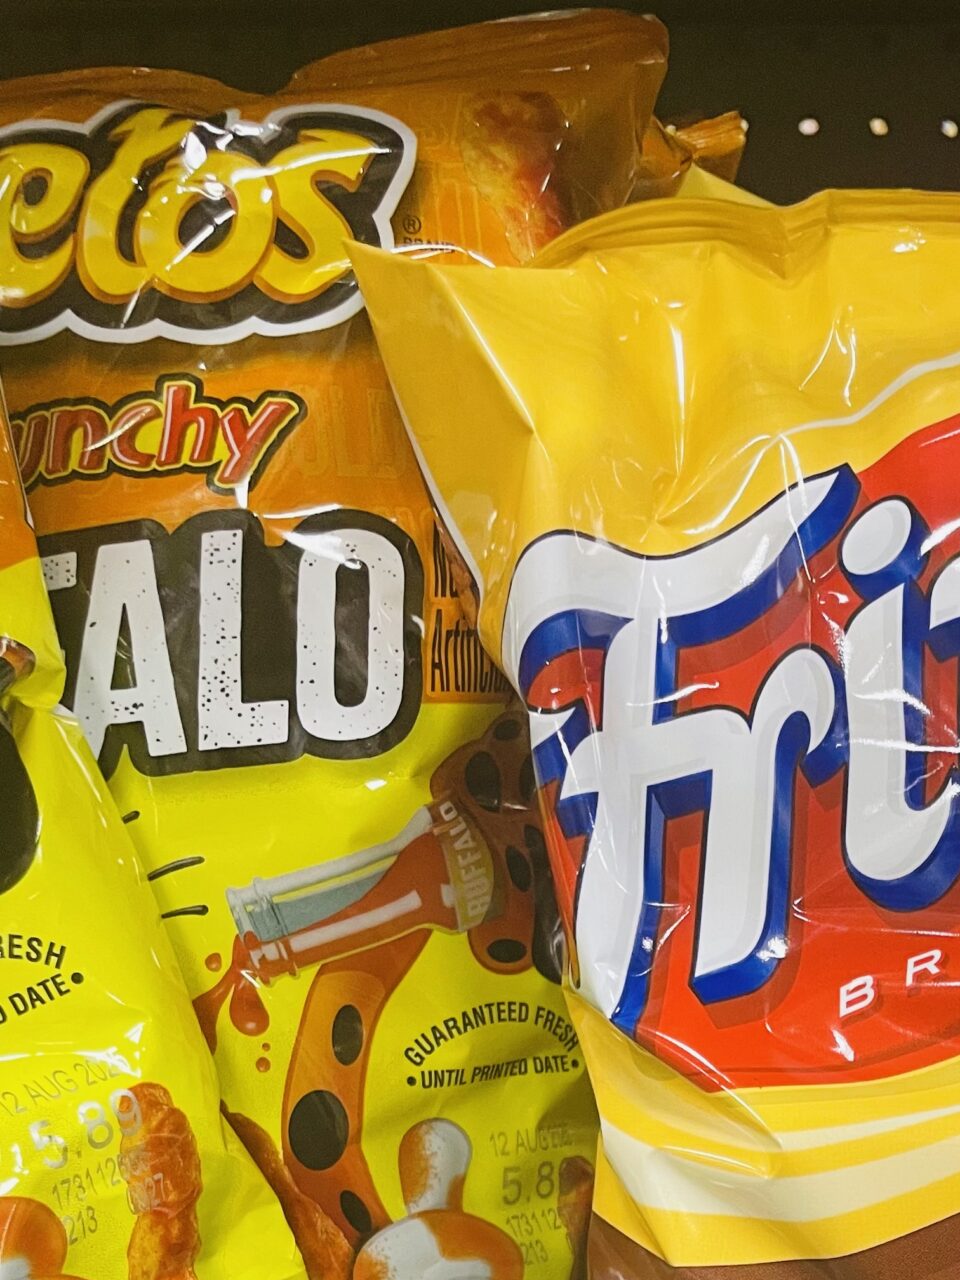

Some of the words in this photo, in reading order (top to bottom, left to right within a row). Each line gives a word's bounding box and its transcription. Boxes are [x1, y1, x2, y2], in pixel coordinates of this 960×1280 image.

[8, 973, 71, 1016] DATE
[404, 1001, 530, 1067] GUARANTEED
[534, 1004, 579, 1052] FRESH
[23, 1068, 79, 1101] AUG
[420, 1068, 467, 1089] UNTIL
[471, 1057, 529, 1083] PRINTED
[534, 1054, 569, 1075] DATE
[29, 1088, 142, 1169] 5.89
